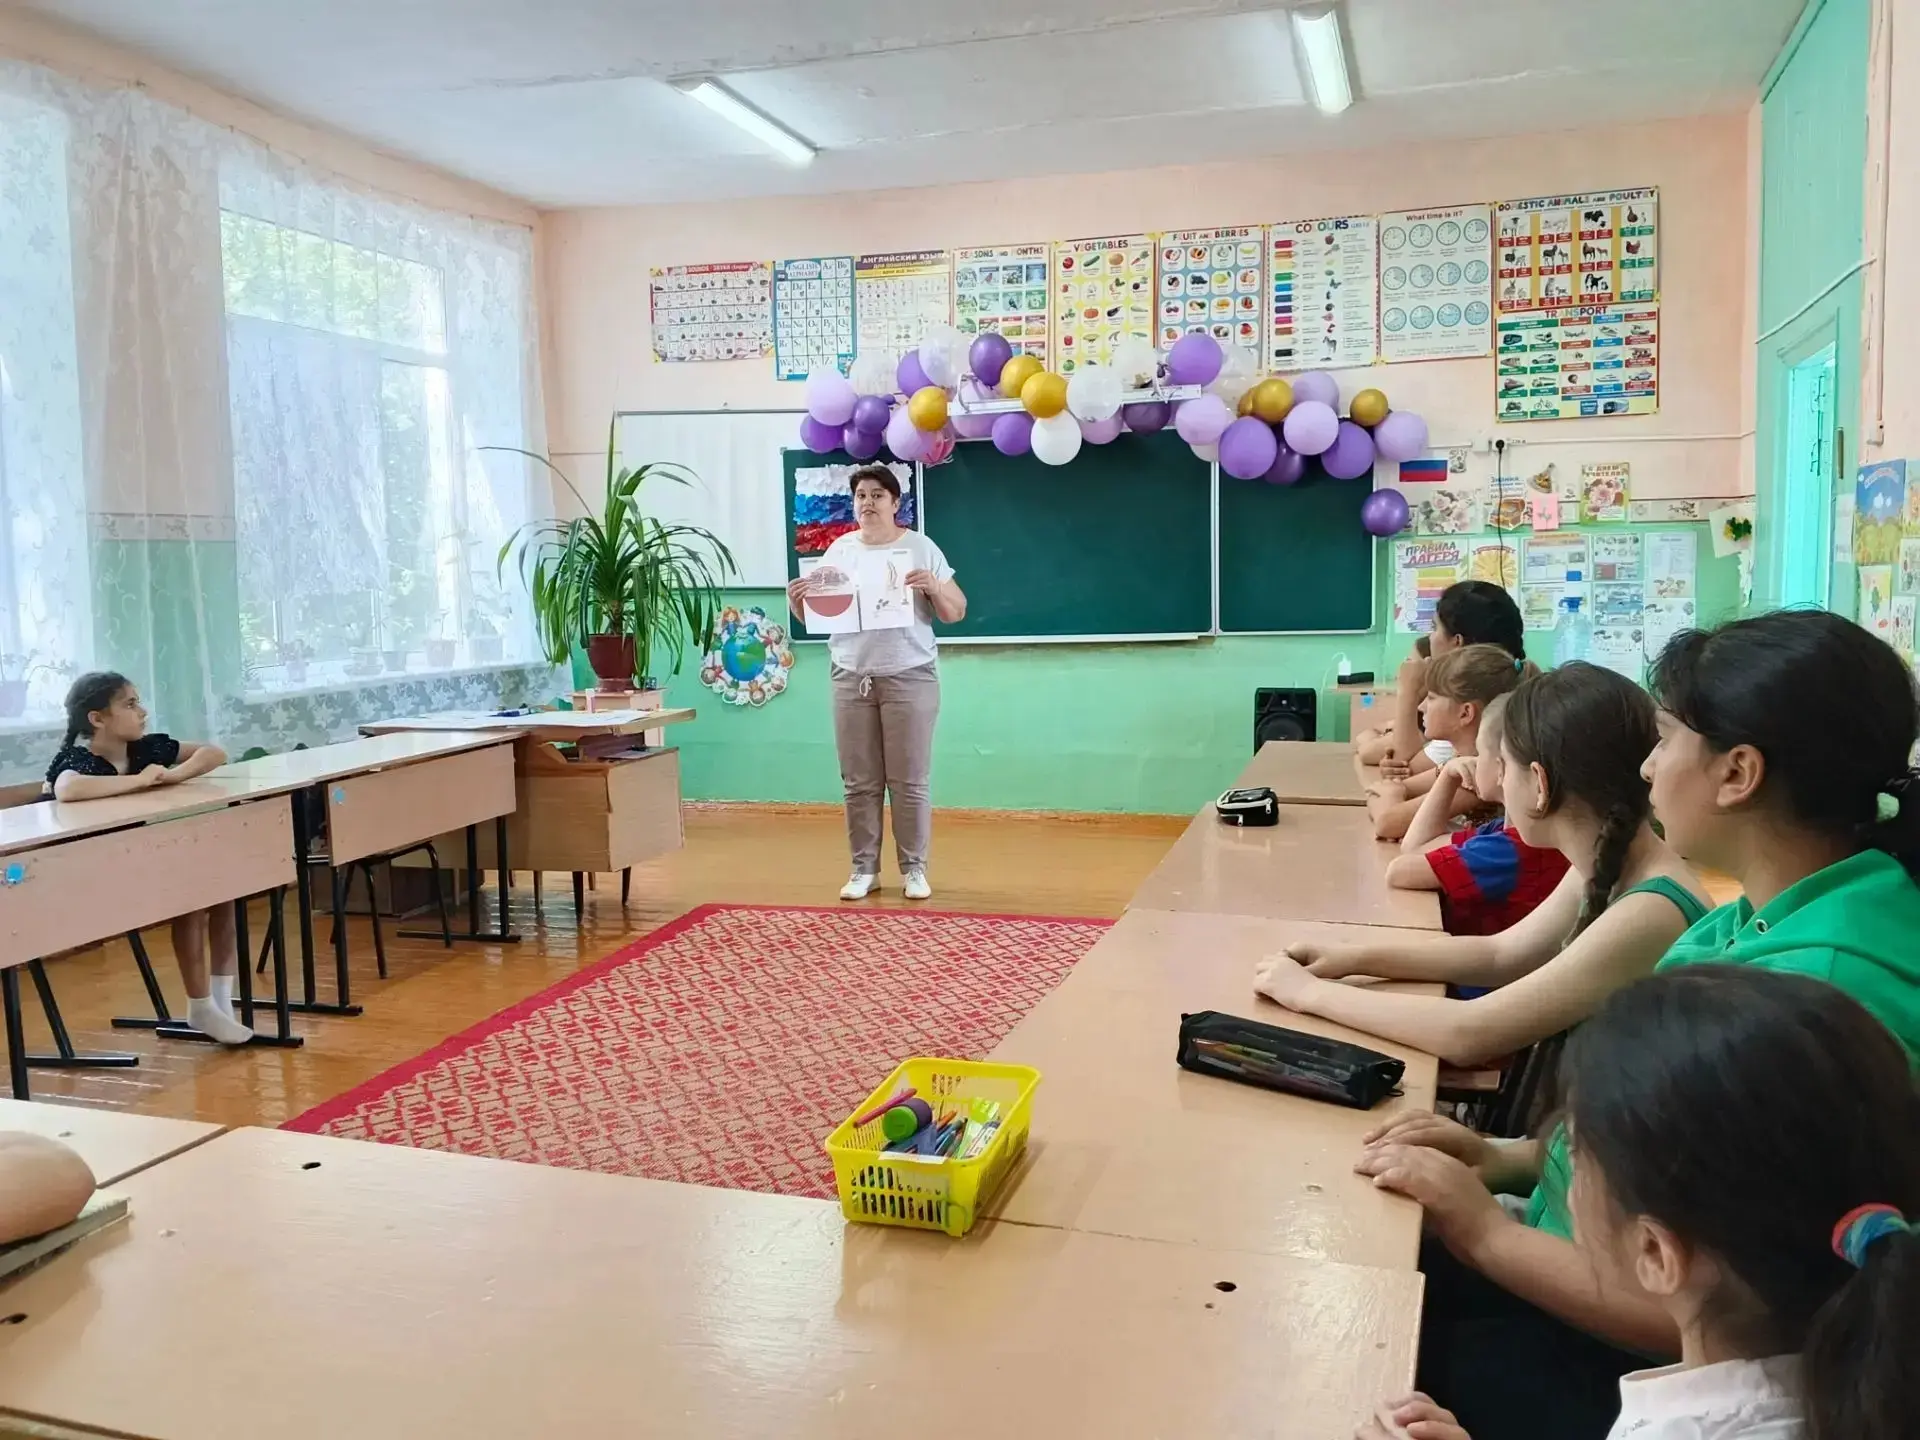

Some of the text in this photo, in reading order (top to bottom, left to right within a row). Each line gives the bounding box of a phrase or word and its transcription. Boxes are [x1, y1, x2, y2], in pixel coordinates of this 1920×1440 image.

[1498, 199, 1545, 211] DOESTIC
[1406, 213, 1425, 221] What
[1296, 220, 1349, 233] COOURS
[1173, 232, 1197, 241] FUIT
[1074, 240, 1128, 252] VGETABLES
[862, 253, 917, 264] АНГЛИЙСКИЙ
[960, 250, 993, 259] SESONS
[1011, 247, 1043, 256] ONTHS
[1545, 306, 1607, 318] TRANSPORT
[1406, 542, 1456, 556] ПРАВИЛА
[1409, 550, 1460, 564] ЛАГЕРЯ
